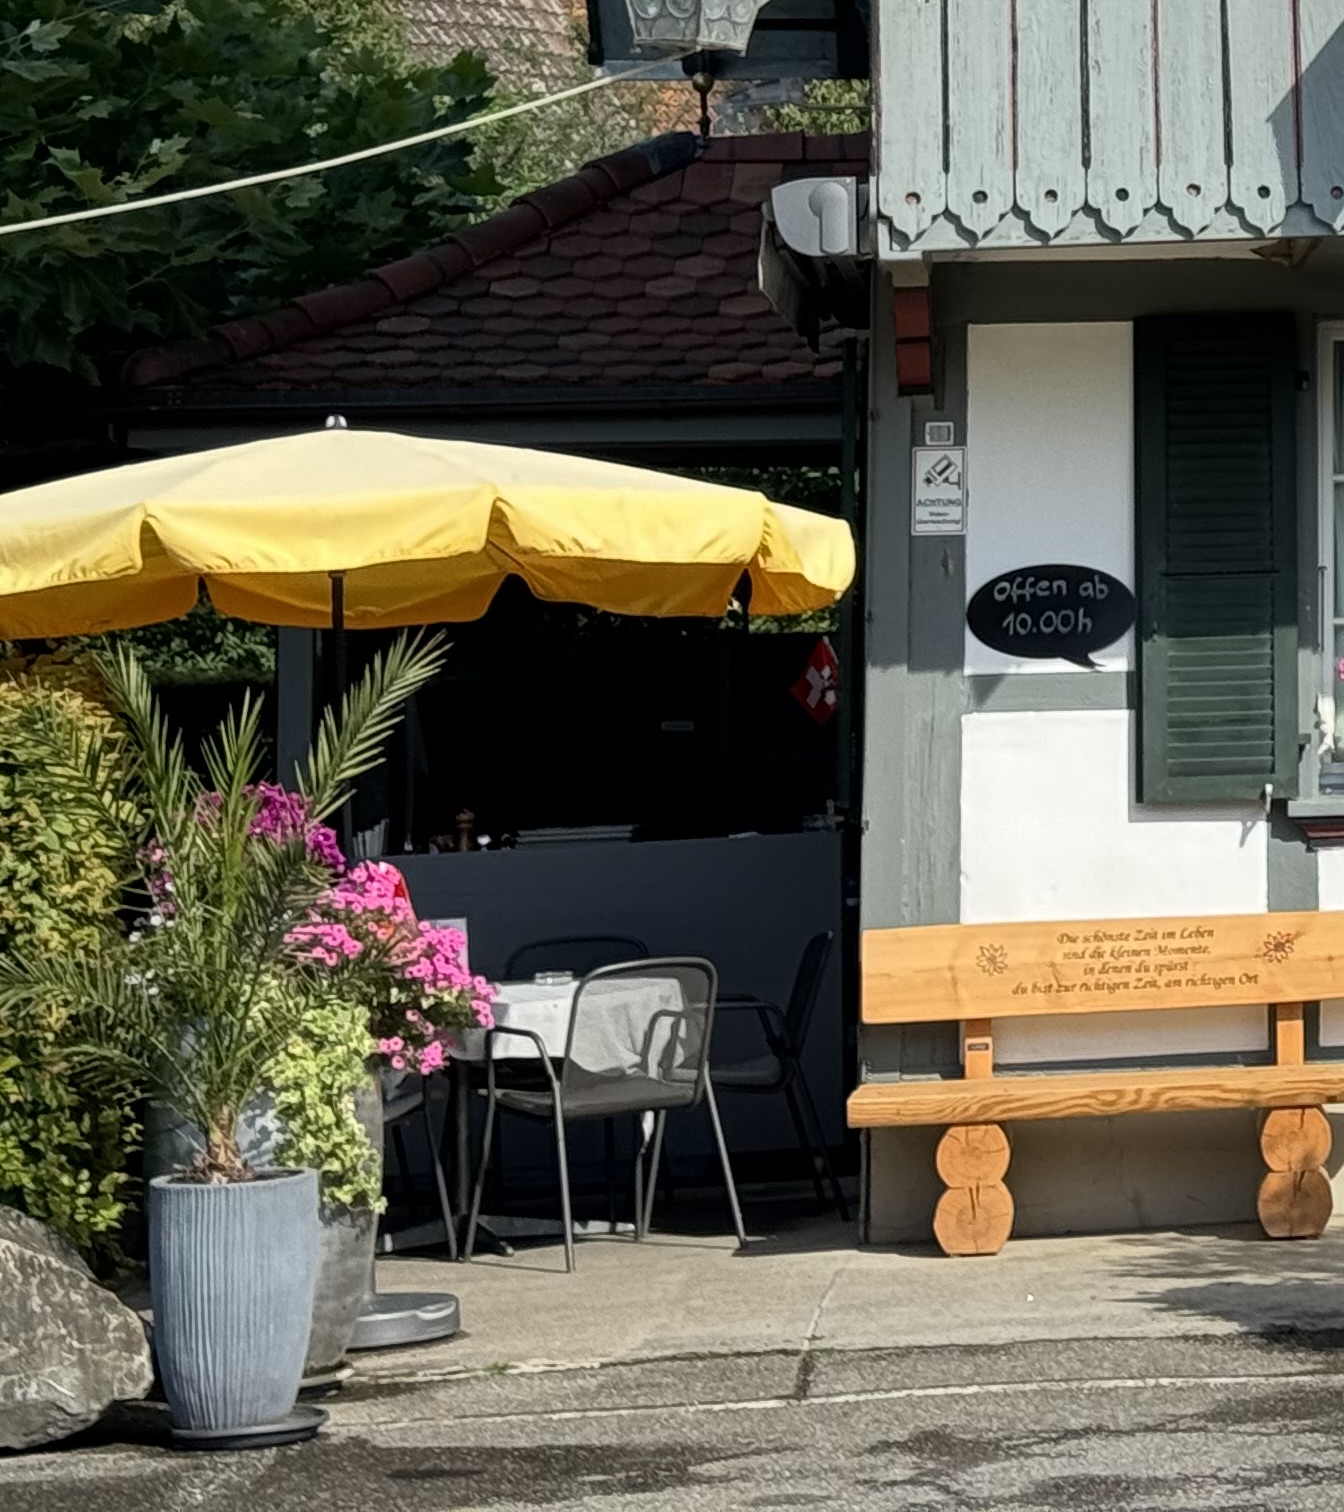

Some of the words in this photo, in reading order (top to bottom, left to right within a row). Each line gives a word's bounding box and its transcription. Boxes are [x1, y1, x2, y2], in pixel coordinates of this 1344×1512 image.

[1079, 574, 1109, 599] ab
[1134, 959, 1151, 974] du
[1238, 972, 1260, 986] Ort
